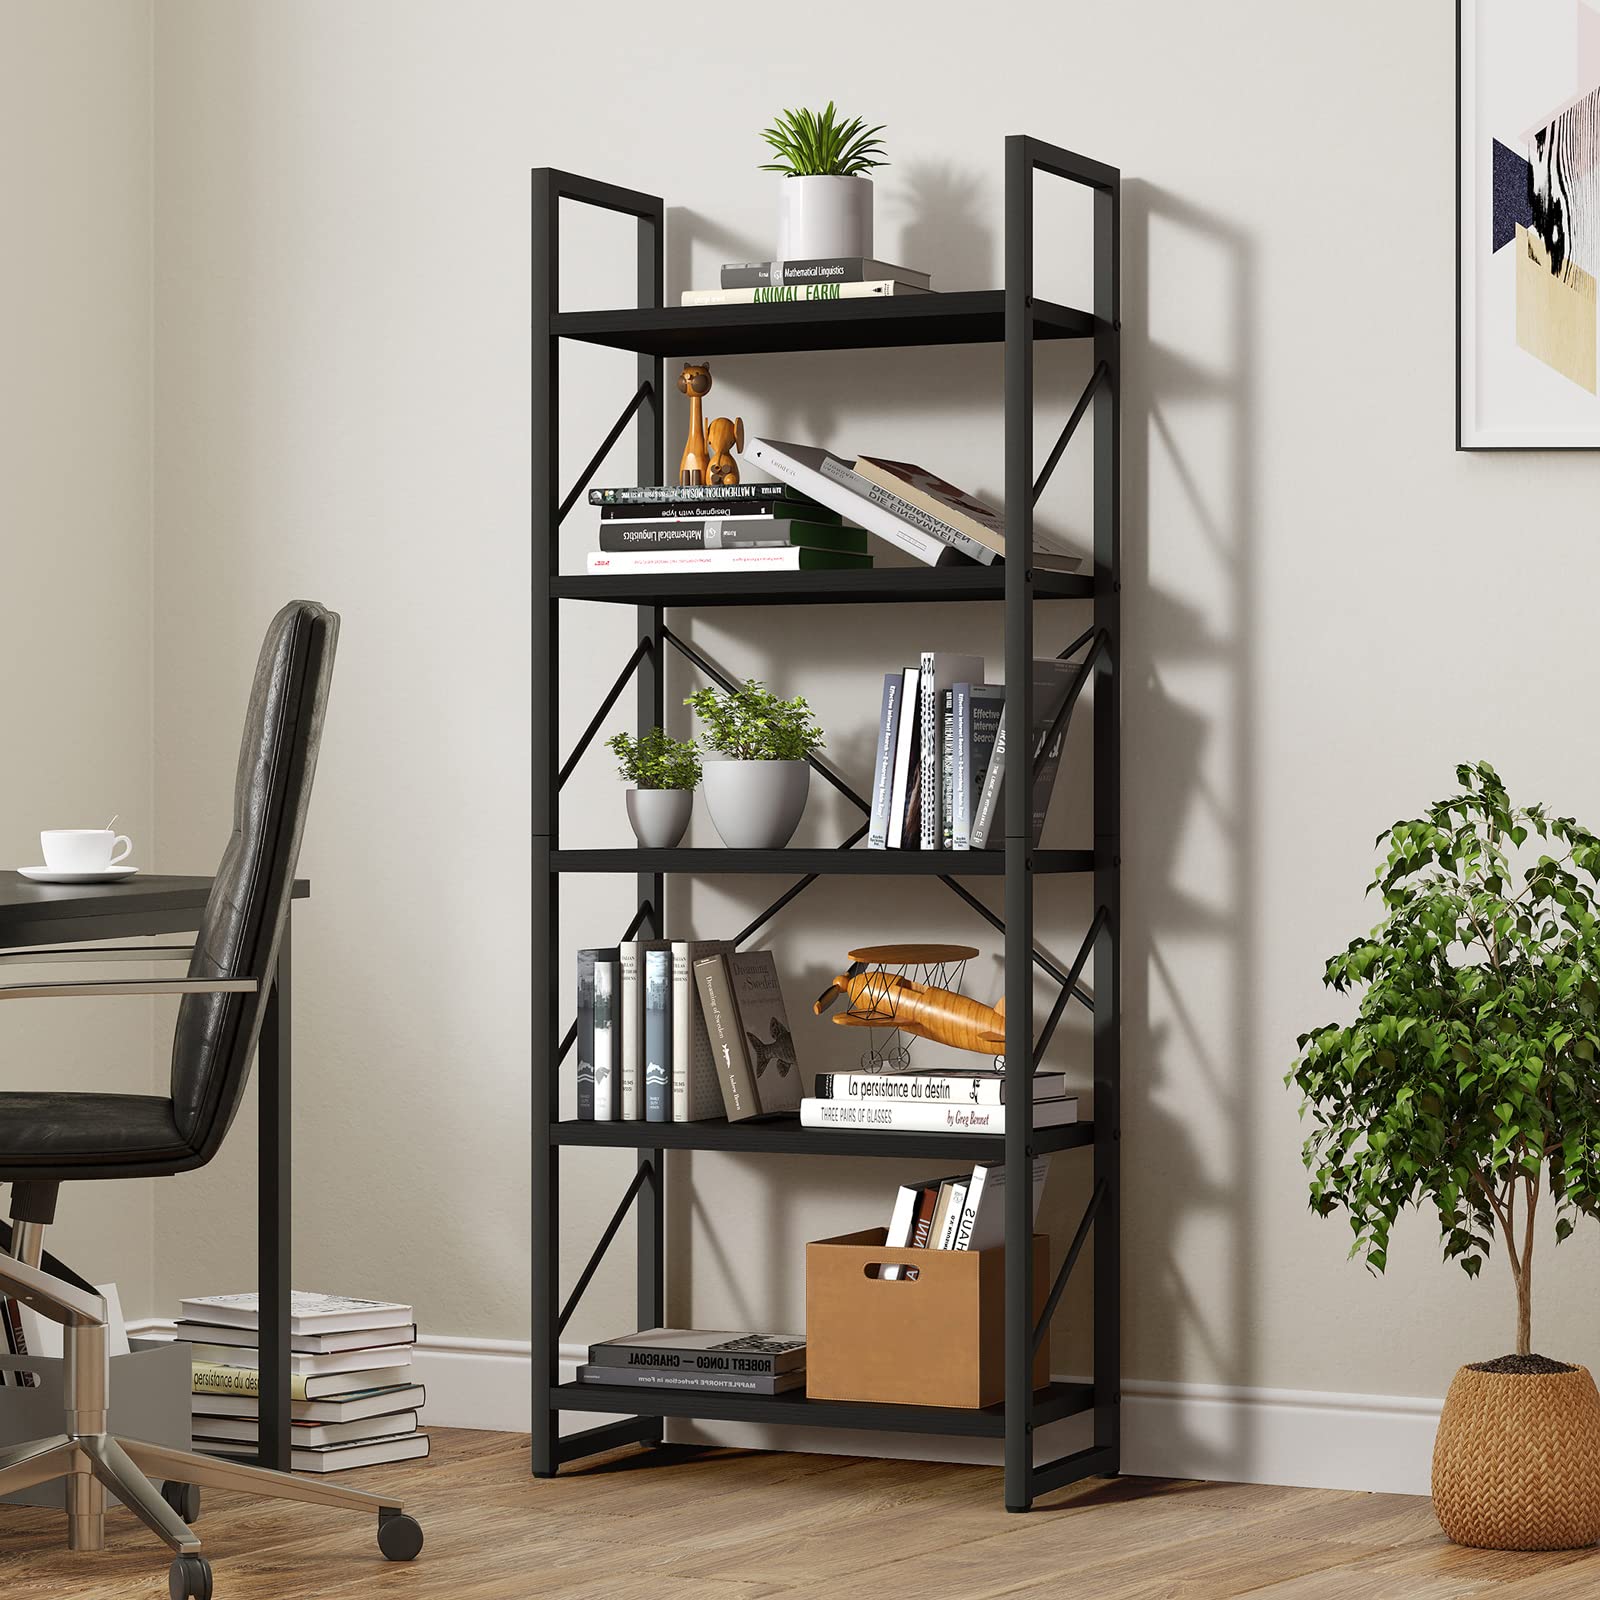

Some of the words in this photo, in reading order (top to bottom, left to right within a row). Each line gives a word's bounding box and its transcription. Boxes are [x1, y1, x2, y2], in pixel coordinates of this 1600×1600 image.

[784, 266, 818, 278] Mathematical
[818, 265, 845, 278] Linguistics
[753, 286, 798, 303] ANIMAL
[805, 283, 840, 301] FARM
[705, 486, 751, 498] MATHEMATICAL
[661, 510, 677, 518] Type
[696, 507, 731, 517] Designing
[623, 529, 657, 542] Linguistics
[658, 530, 702, 542] Mathematical
[888, 685, 896, 709] Effective
[973, 707, 1000, 721] Effective
[706, 976, 717, 1007] Dreaming
[714, 1006, 720, 1014] of
[714, 1014, 724, 1039] Sweden
[848, 1075, 858, 1096] La
[860, 1076, 908, 1101] persistance
[910, 1078, 922, 1098] du
[924, 1078, 950, 1099] destin
[733, 1094, 741, 1111] Brown
[821, 1107, 839, 1122] THREE
[840, 1108, 856, 1122] PAIRS
[858, 1108, 865, 1123] OF
[866, 1109, 892, 1124] GLASSES
[946, 1110, 955, 1126] by
[955, 1110, 969, 1127] Greg
[194, 1369, 232, 1391] persistance
[234, 1371, 244, 1389] du
